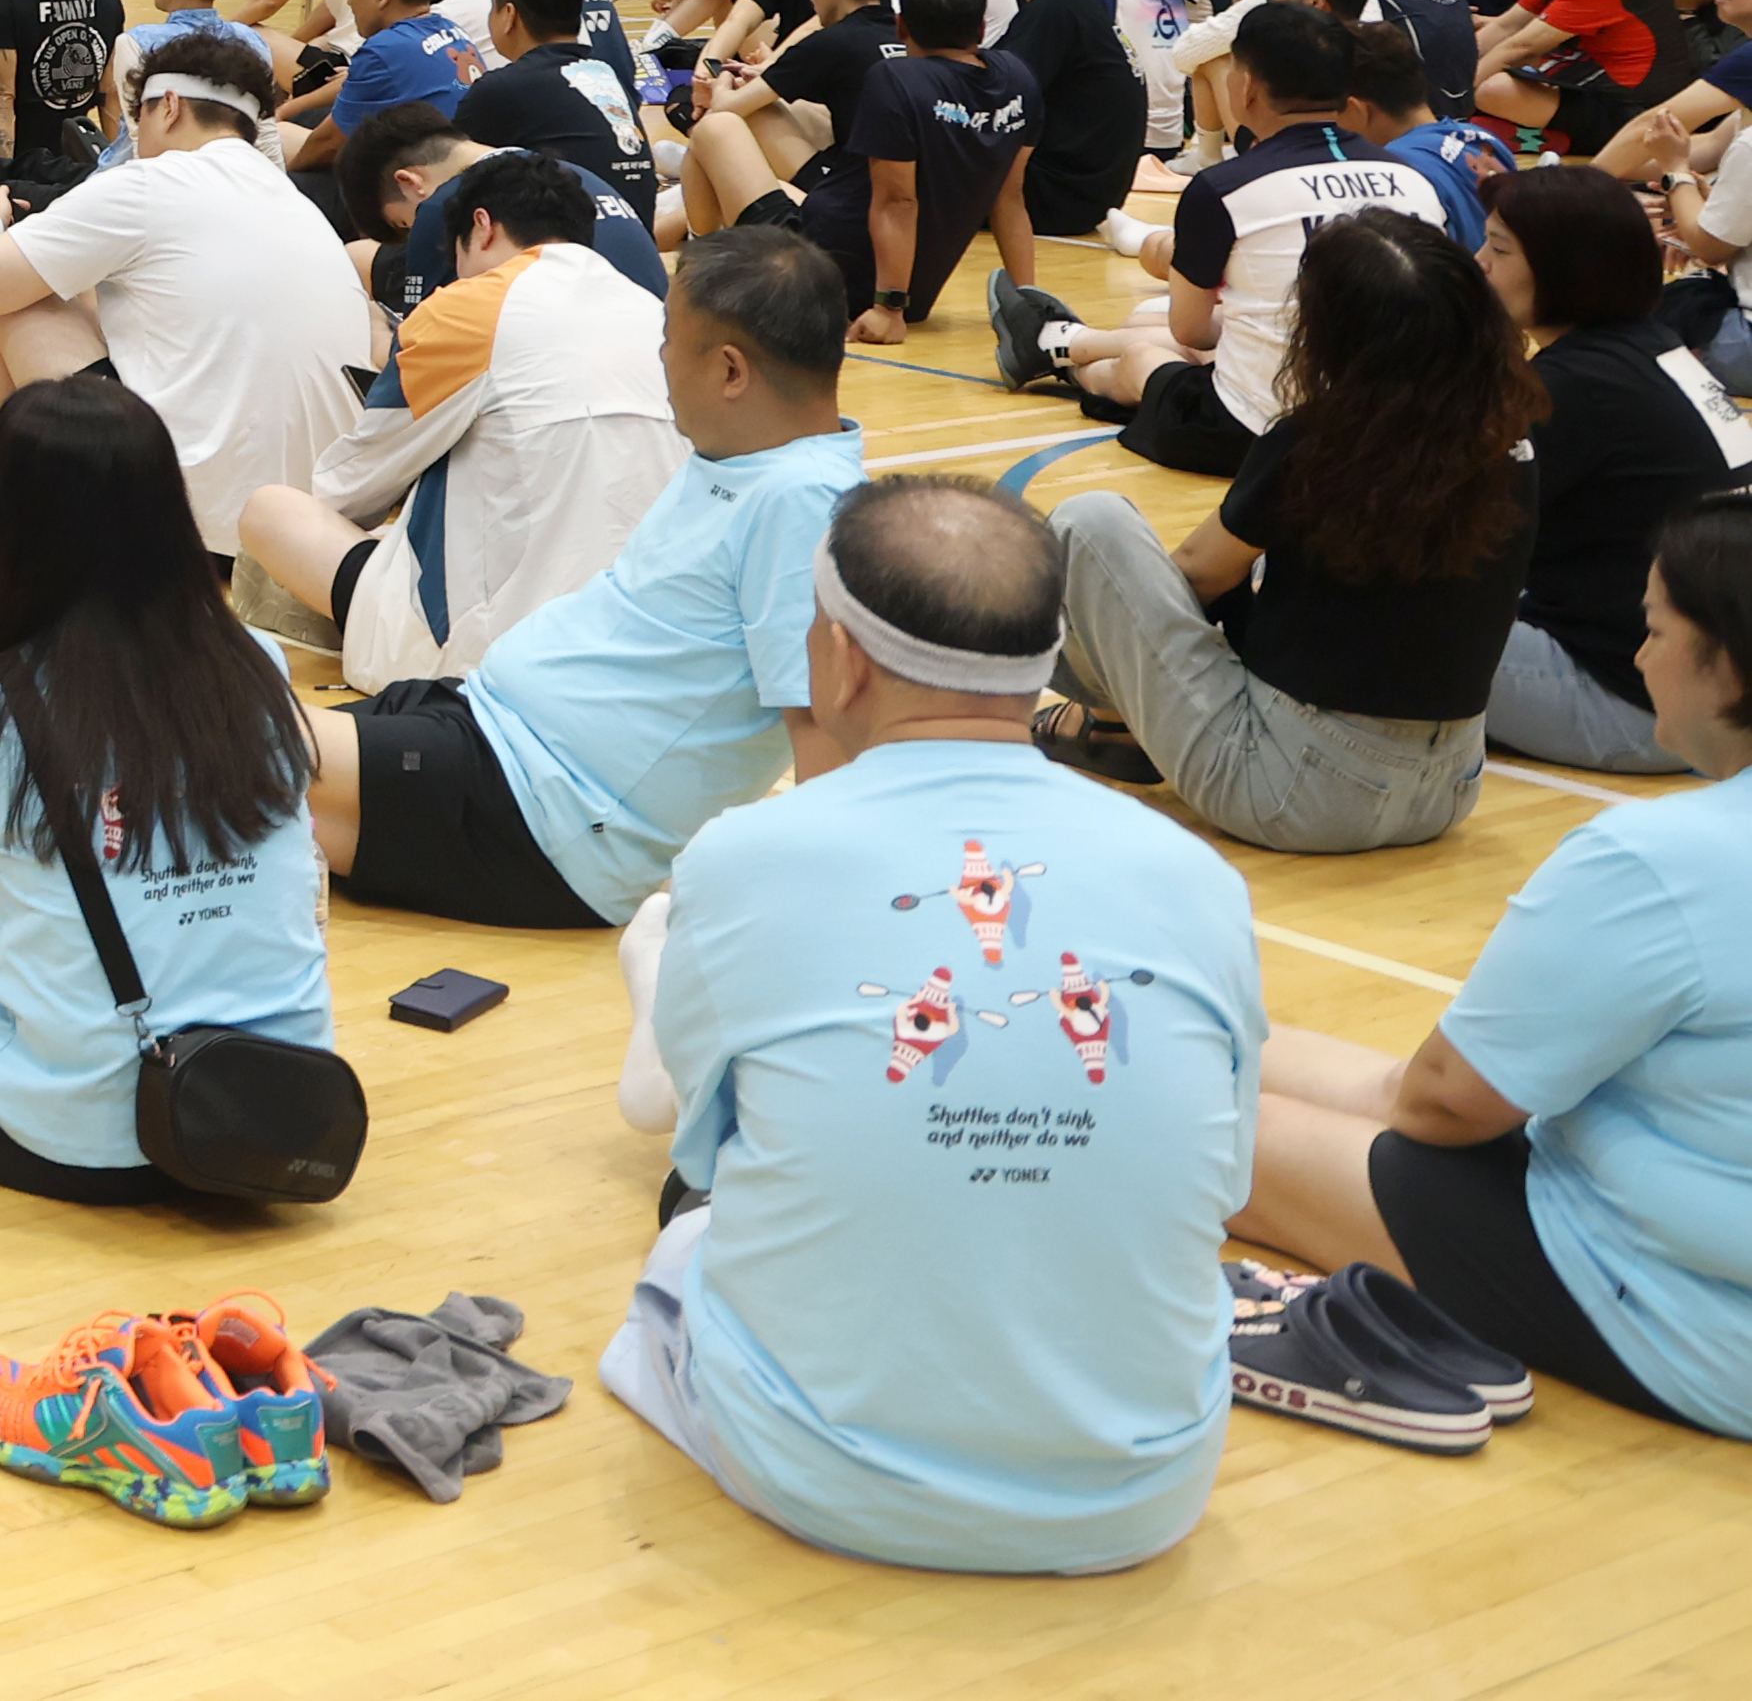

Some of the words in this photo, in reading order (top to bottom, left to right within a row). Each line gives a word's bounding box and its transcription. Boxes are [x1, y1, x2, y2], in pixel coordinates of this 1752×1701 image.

[1300, 171, 1404, 201] YONEX
[144, 886, 169, 902] and
[173, 878, 215, 898] neither
[218, 874, 234, 888] do
[238, 872, 256, 885] we
[198, 904, 233, 919] YONEX
[927, 1103, 1000, 1128] Shuttles
[1005, 1105, 1052, 1129] don't
[1056, 1107, 1096, 1130] sink
[927, 1127, 965, 1150] and
[968, 1127, 1032, 1151] neither
[1036, 1128, 1058, 1146] do
[1064, 1133, 1090, 1147] we
[308, 1160, 336, 1179] YONEX
[1001, 1167, 1052, 1183] YONEX
[1232, 1372, 1308, 1409] OCS
